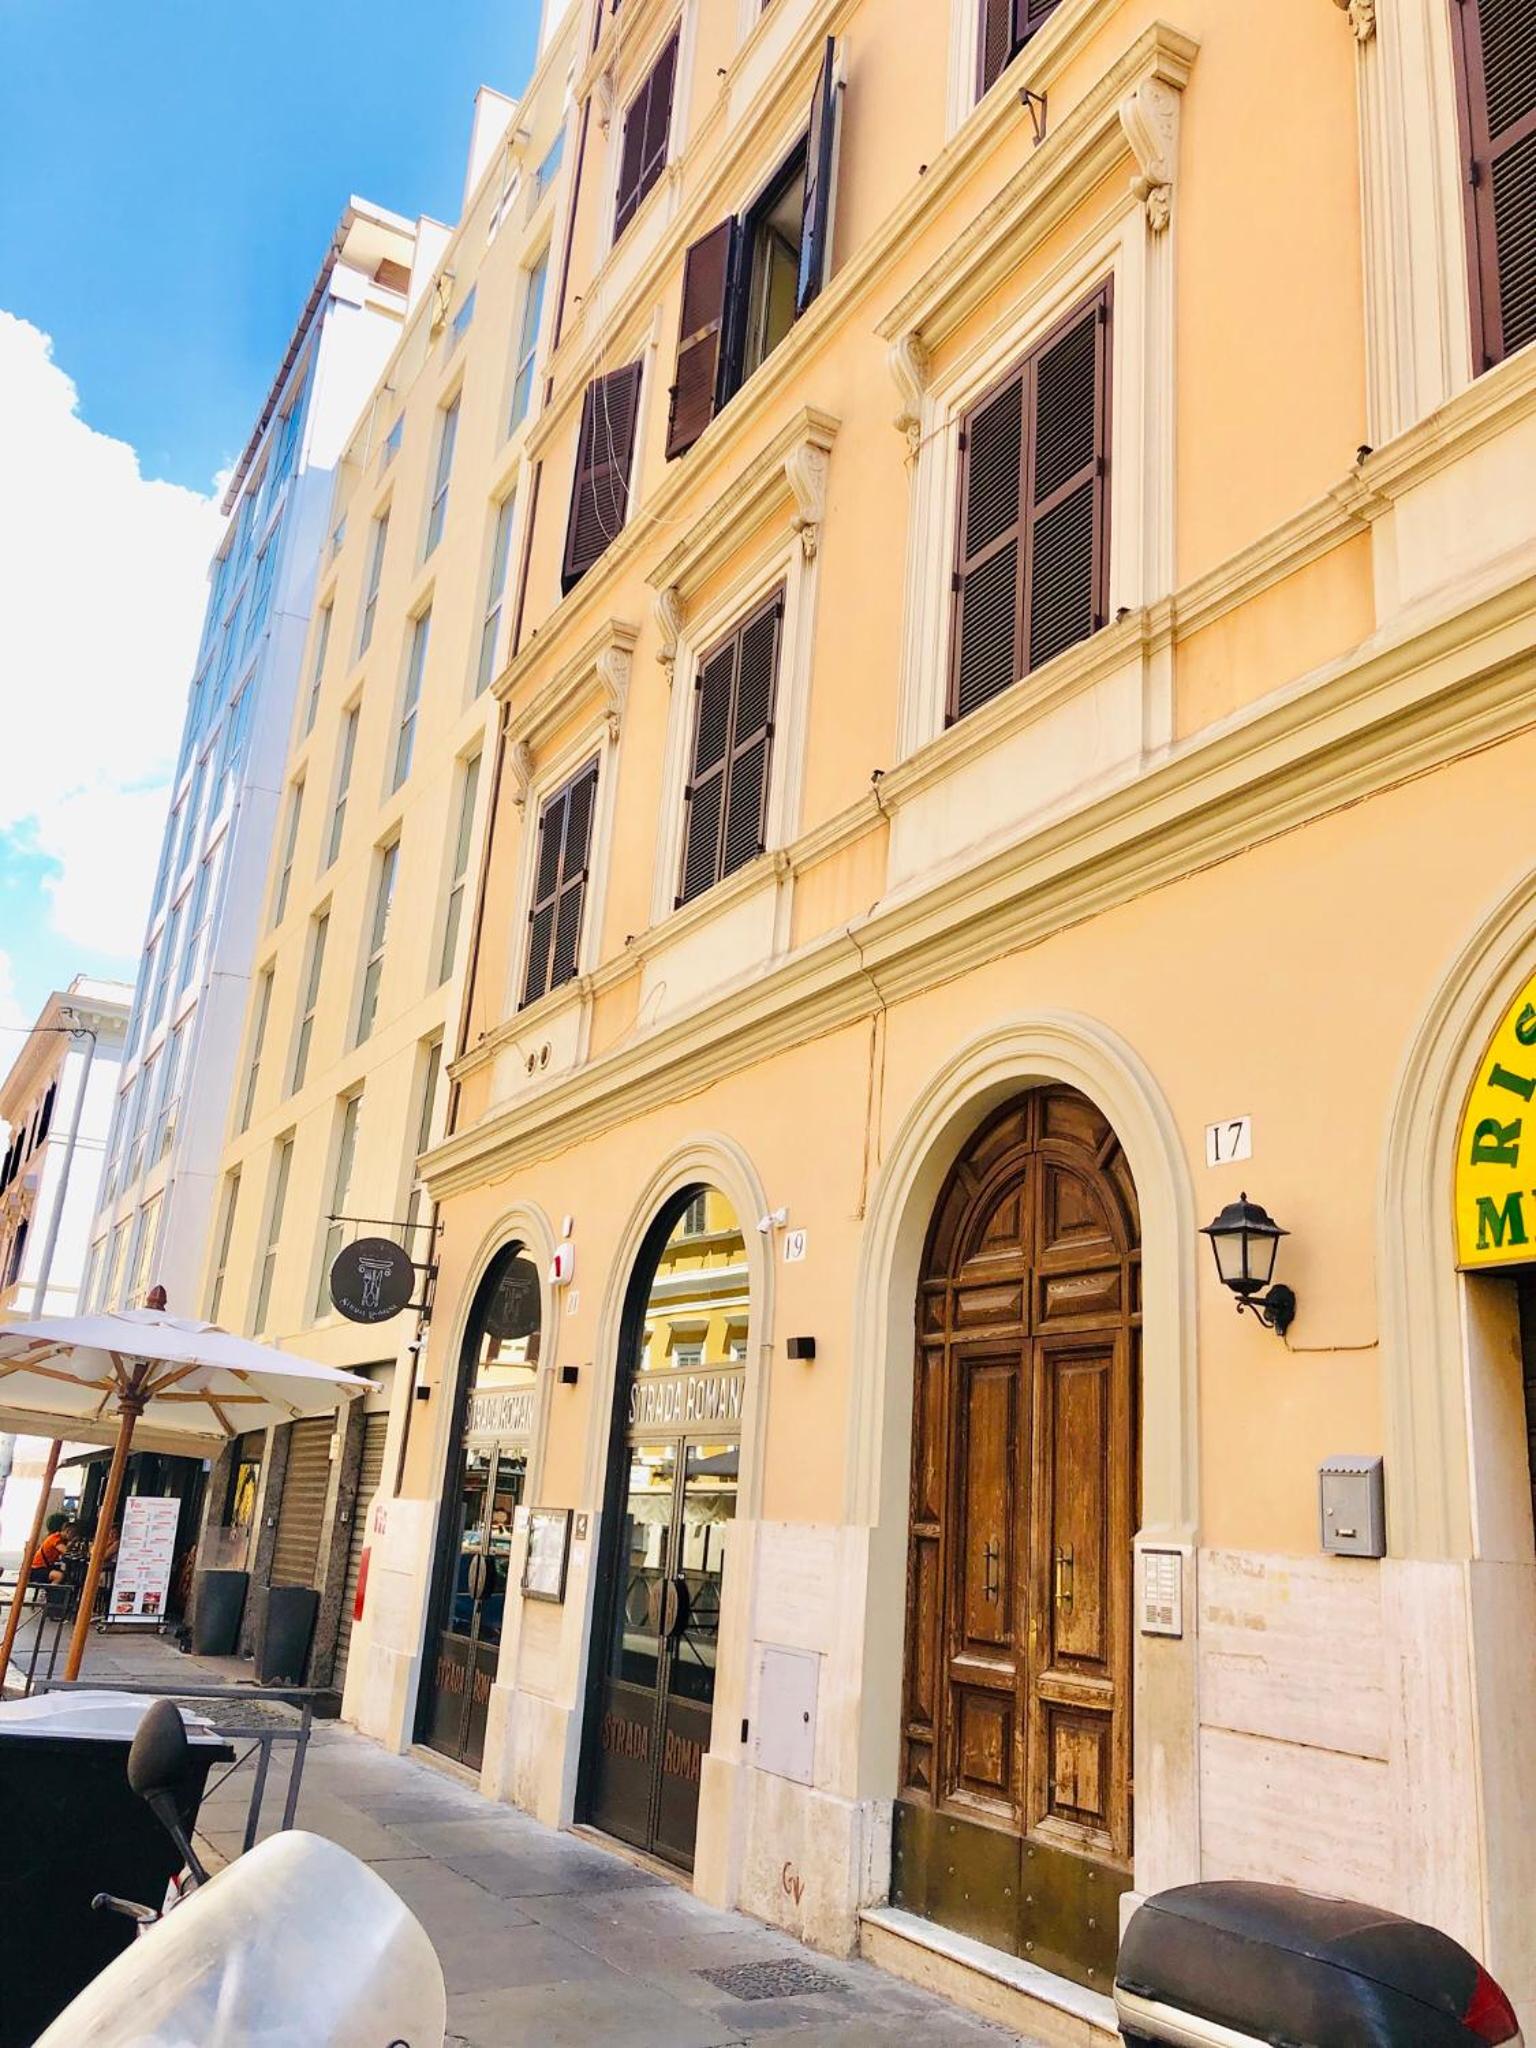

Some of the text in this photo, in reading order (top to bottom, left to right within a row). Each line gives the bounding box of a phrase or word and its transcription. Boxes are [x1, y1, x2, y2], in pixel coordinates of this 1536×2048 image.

[1214, 1121, 1243, 1161] 17
[1476, 1189, 1536, 1250] M
[786, 1232, 804, 1260] 19
[629, 1381, 682, 1423] STRADA
[602, 1712, 706, 1781] STRADA ROMA
